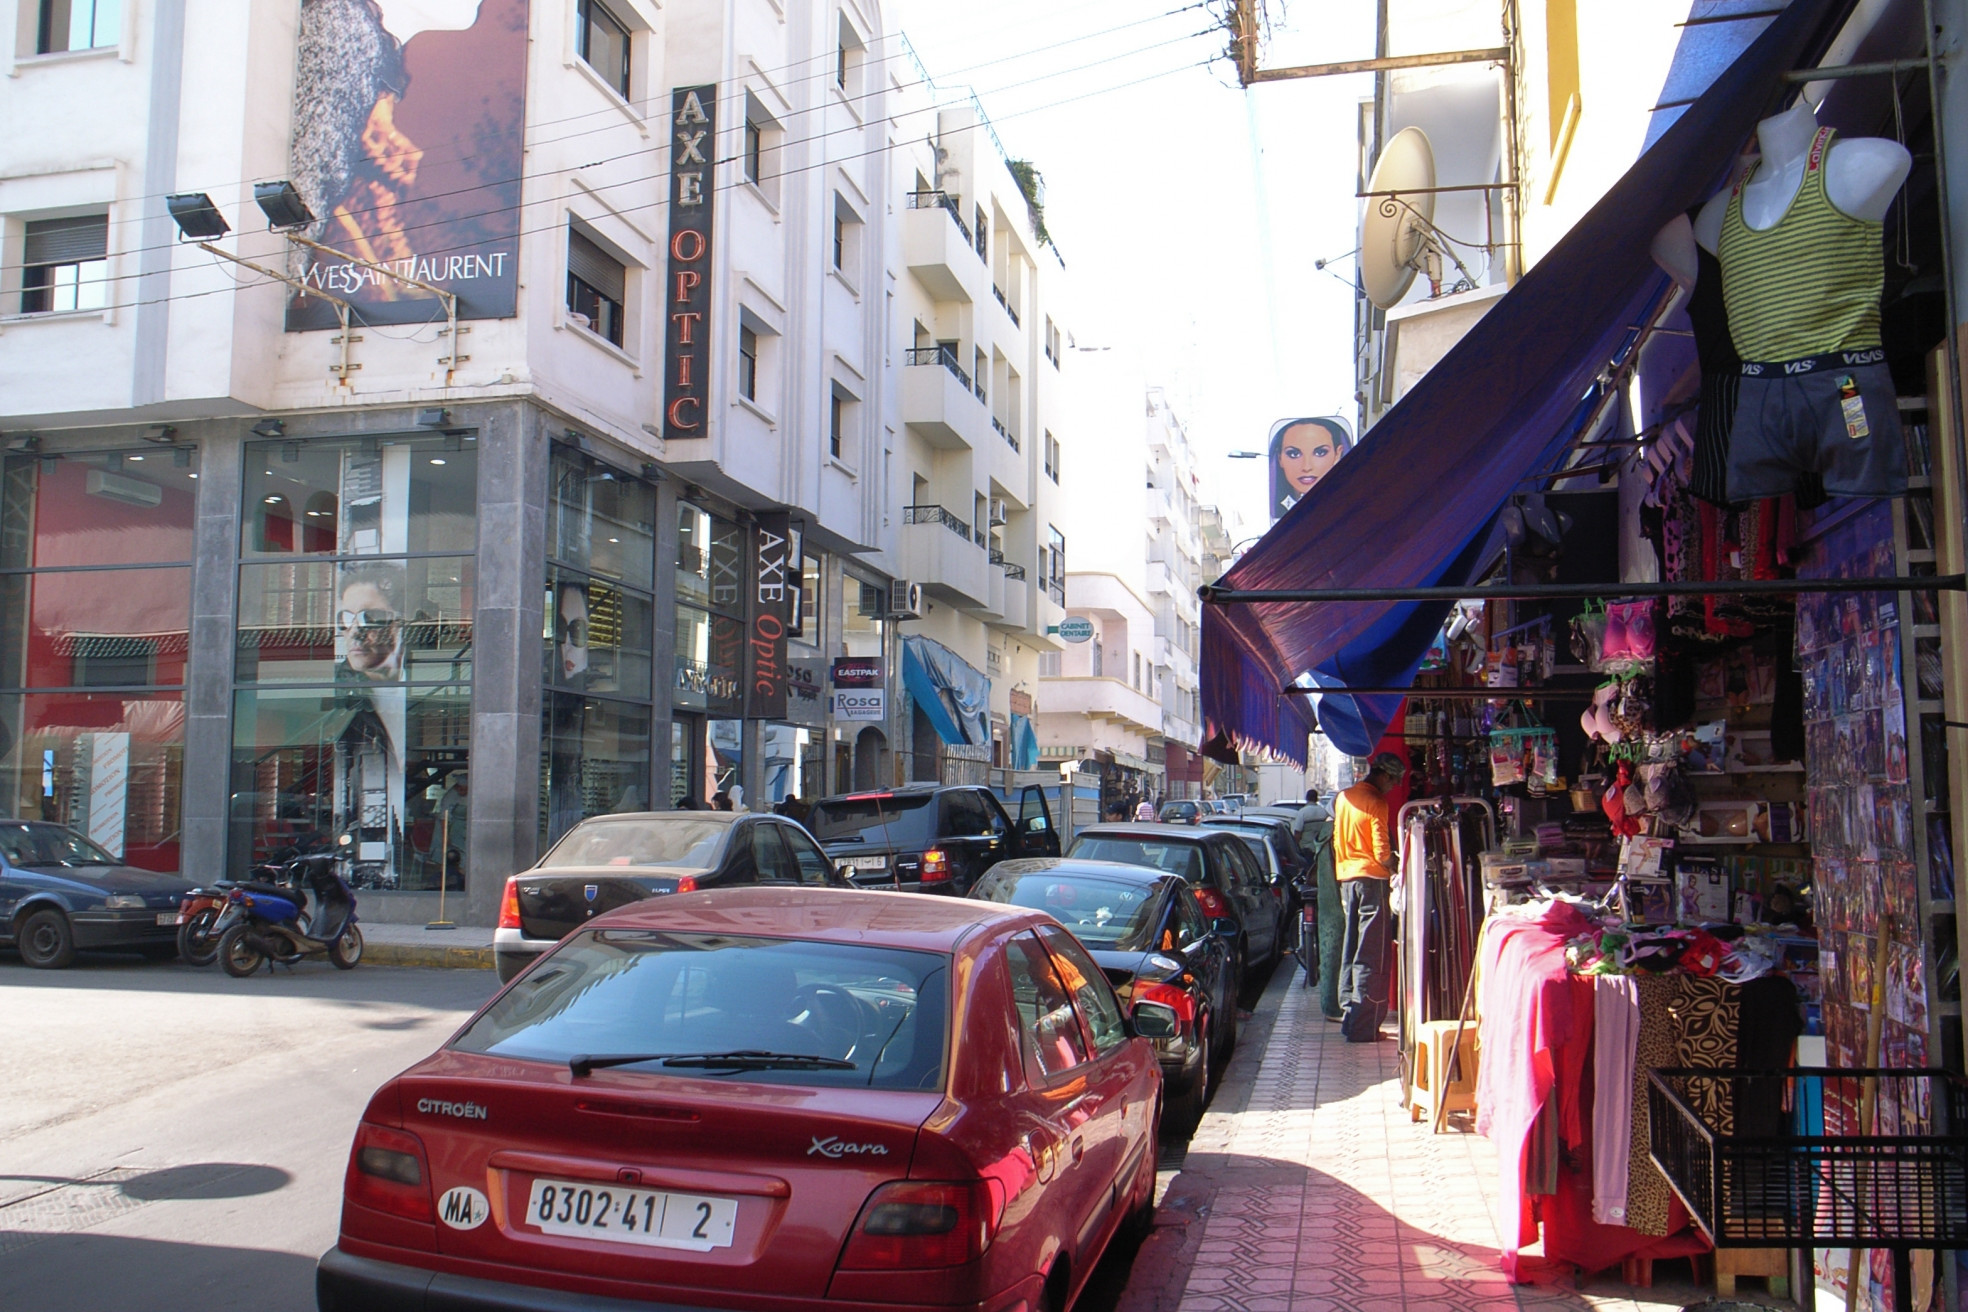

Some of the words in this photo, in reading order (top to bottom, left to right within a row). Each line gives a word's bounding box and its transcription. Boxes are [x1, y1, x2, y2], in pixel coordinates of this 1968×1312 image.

[675, 90, 710, 206] AXE
[668, 228, 707, 430] OPTIC
[758, 527, 785, 604] AXE
[1060, 622, 1090, 630] CABINET
[749, 613, 783, 697] Optic
[838, 668, 879, 676] EASTPAK
[837, 694, 881, 717] Rosa
[417, 1098, 488, 1120] CITROËN
[806, 1135, 889, 1158] Xsara
[444, 1190, 473, 1224] MA
